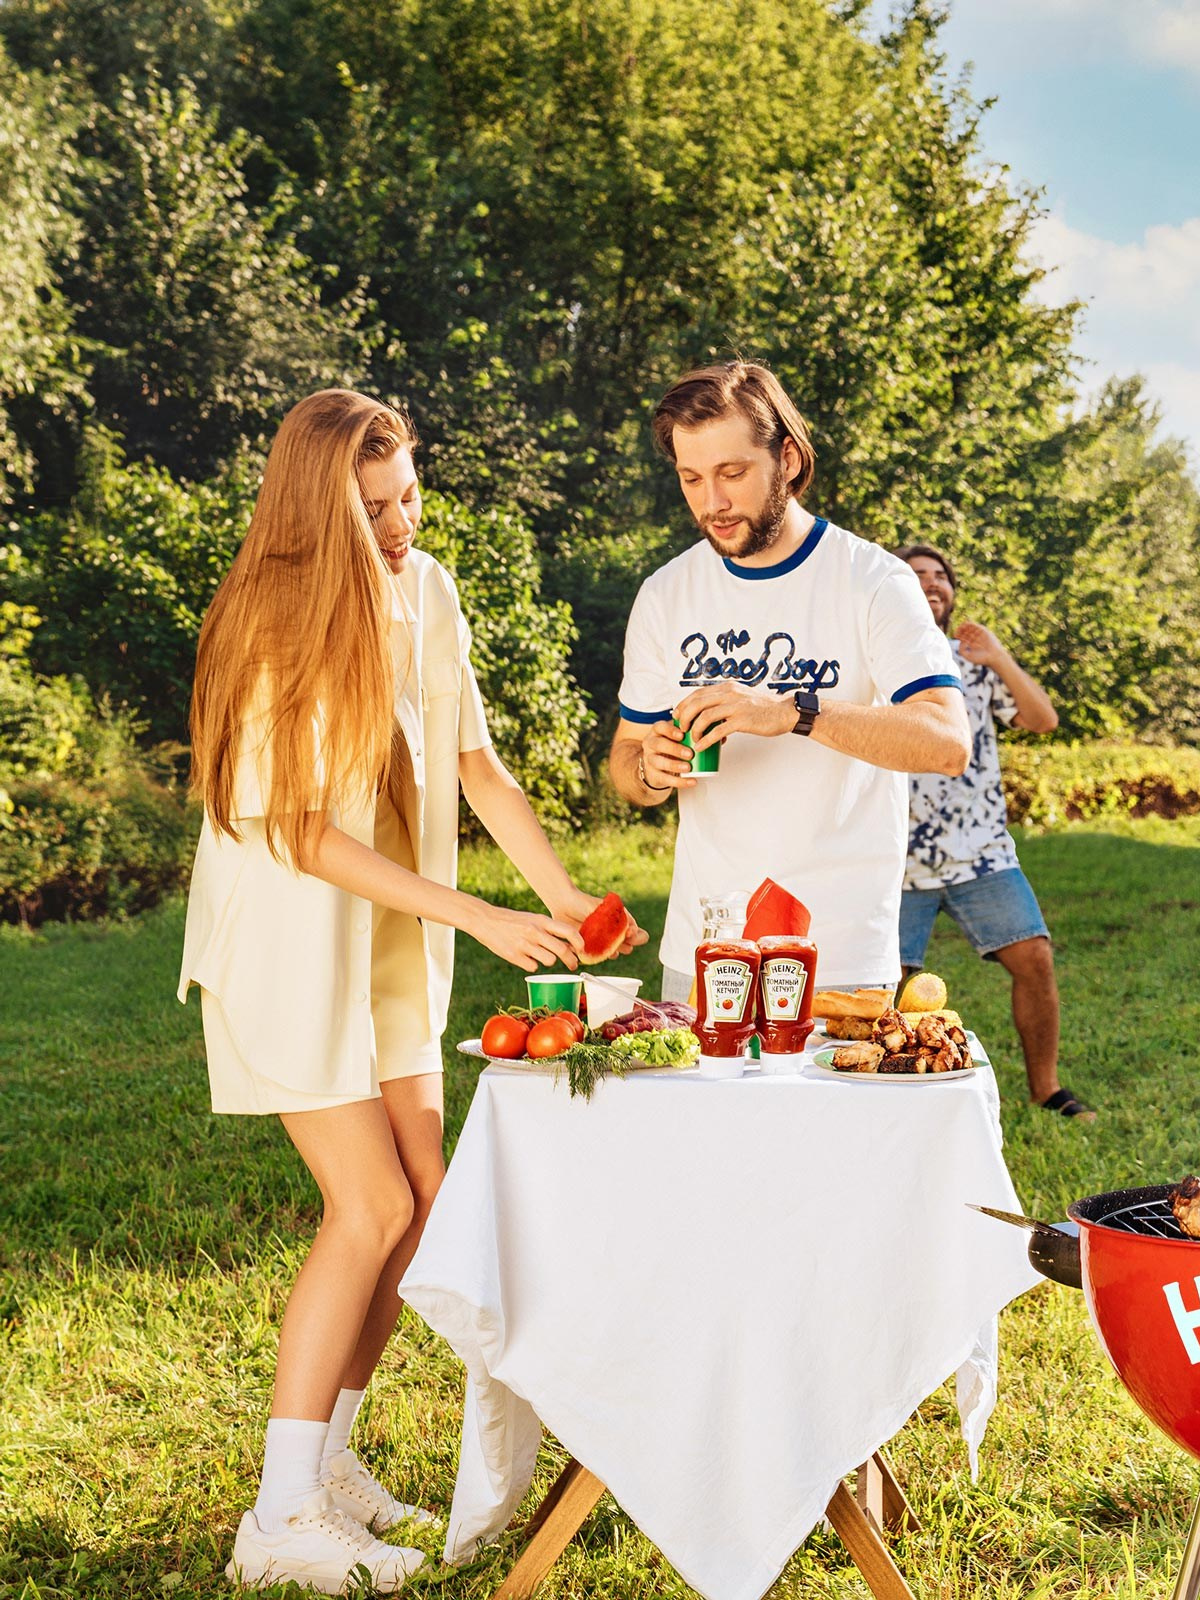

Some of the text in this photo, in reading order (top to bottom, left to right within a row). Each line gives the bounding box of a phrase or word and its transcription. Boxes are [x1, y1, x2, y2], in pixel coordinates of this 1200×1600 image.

[763, 632, 841, 694] Boys
[716, 966, 743, 976] HEINZ
[771, 965, 797, 975] HEINZ
[767, 977, 799, 986] ТОМАТНЫЙ
[716, 987, 740, 995] КЕТЧУП
[771, 985, 795, 993] КЕТЧУП
